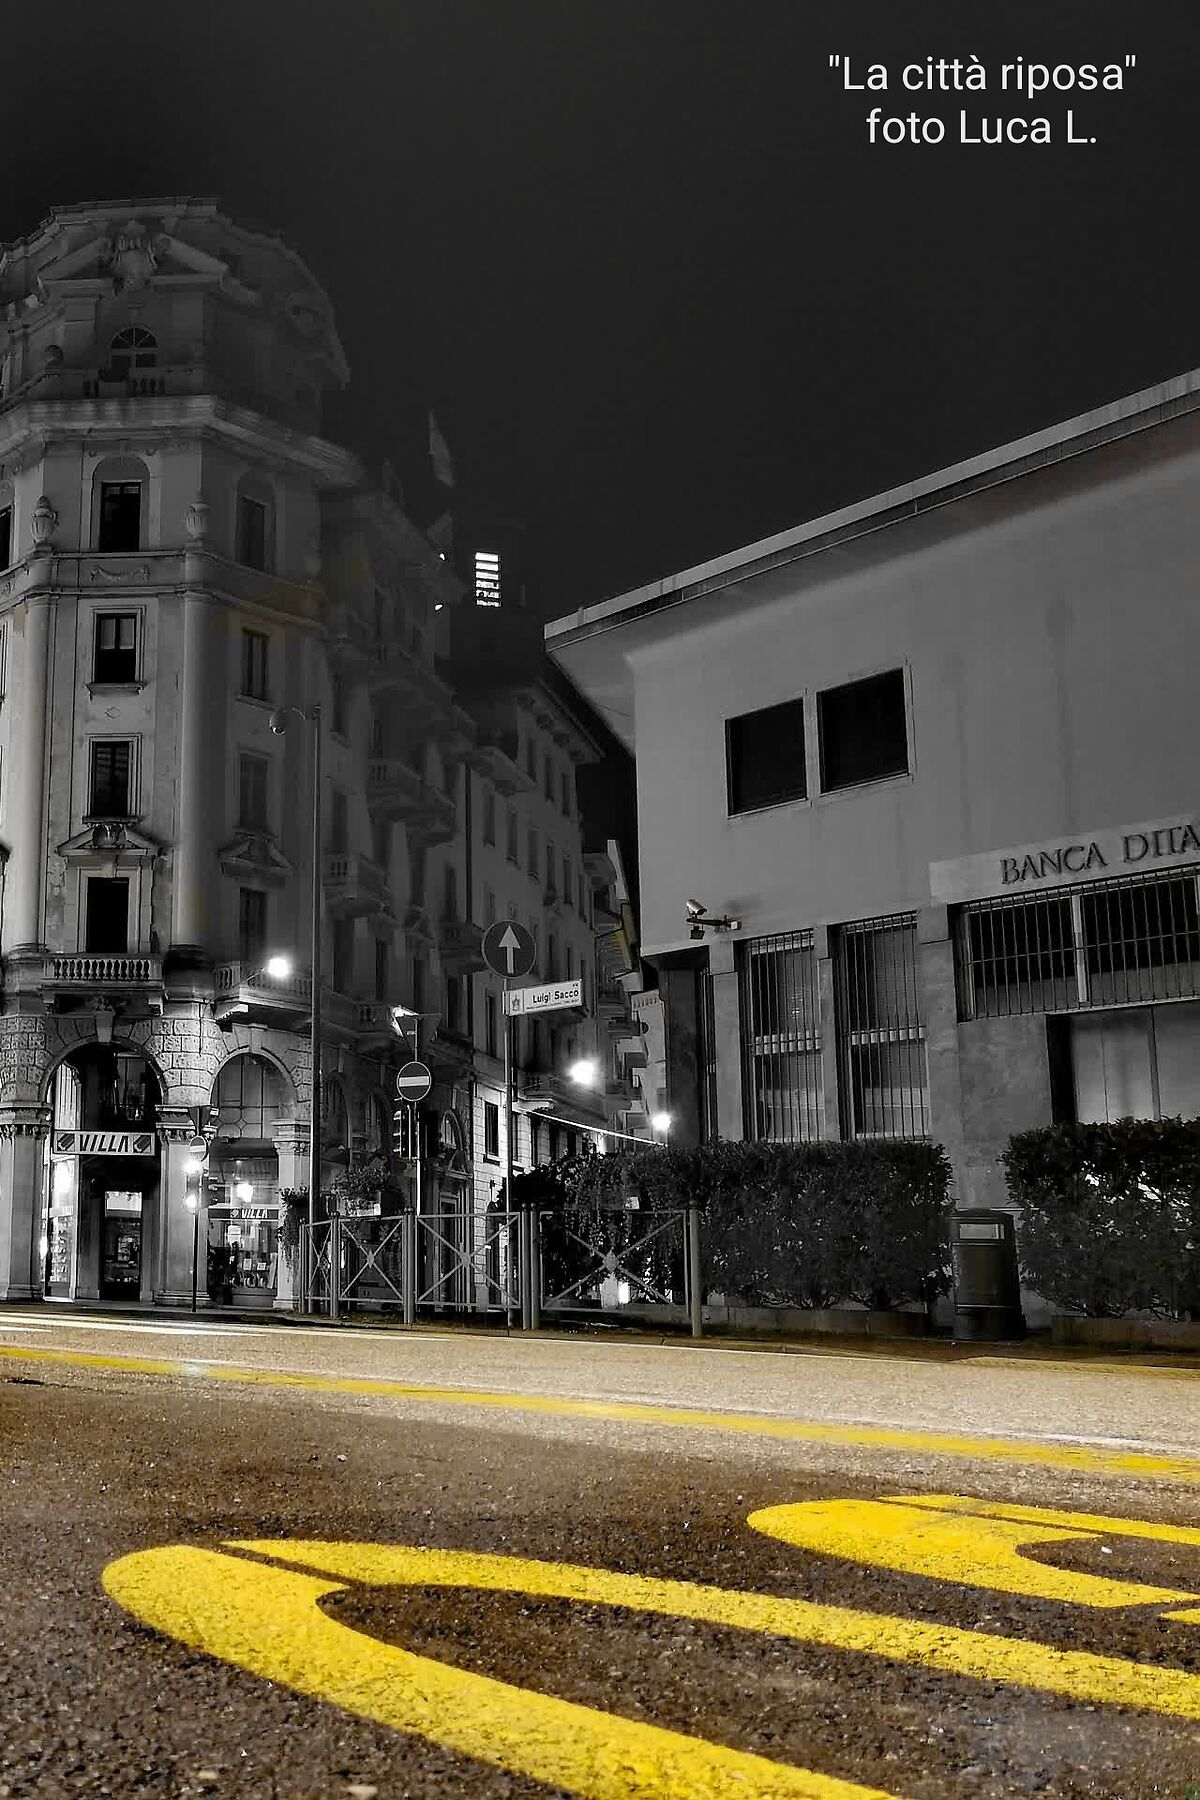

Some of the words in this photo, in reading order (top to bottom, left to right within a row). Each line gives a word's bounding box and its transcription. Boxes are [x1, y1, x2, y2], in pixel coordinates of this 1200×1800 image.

[1000, 842, 1109, 885] BANCA
[532, 992, 551, 1004] Luigi
[554, 990, 579, 1000] Sacco
[79, 1134, 129, 1152] VILLA
[241, 1208, 268, 1219] VILLA
